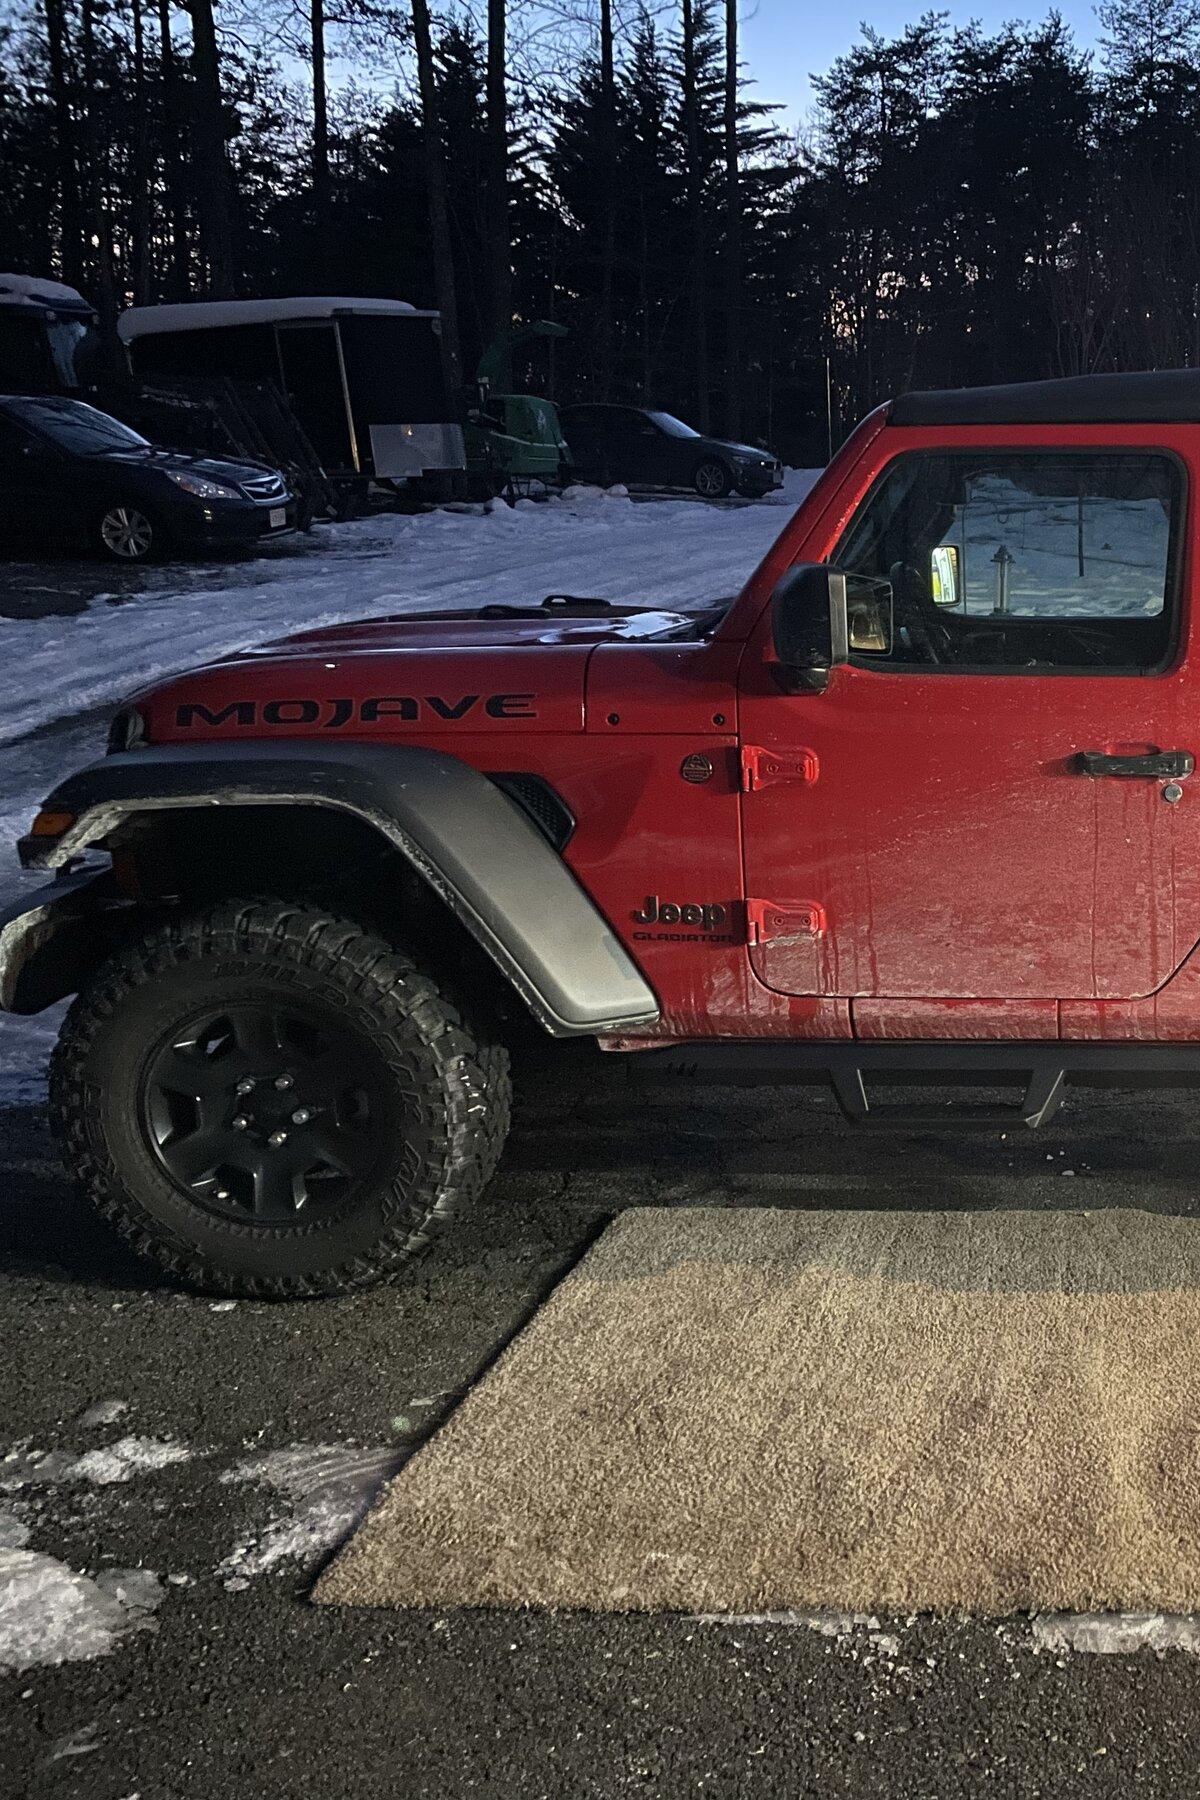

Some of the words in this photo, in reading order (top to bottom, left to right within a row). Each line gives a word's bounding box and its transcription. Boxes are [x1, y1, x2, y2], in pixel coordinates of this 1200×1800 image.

[175, 692, 540, 729] MOJAVE
[632, 895, 727, 932] Jeep
[631, 931, 734, 943] GLADIATOR
